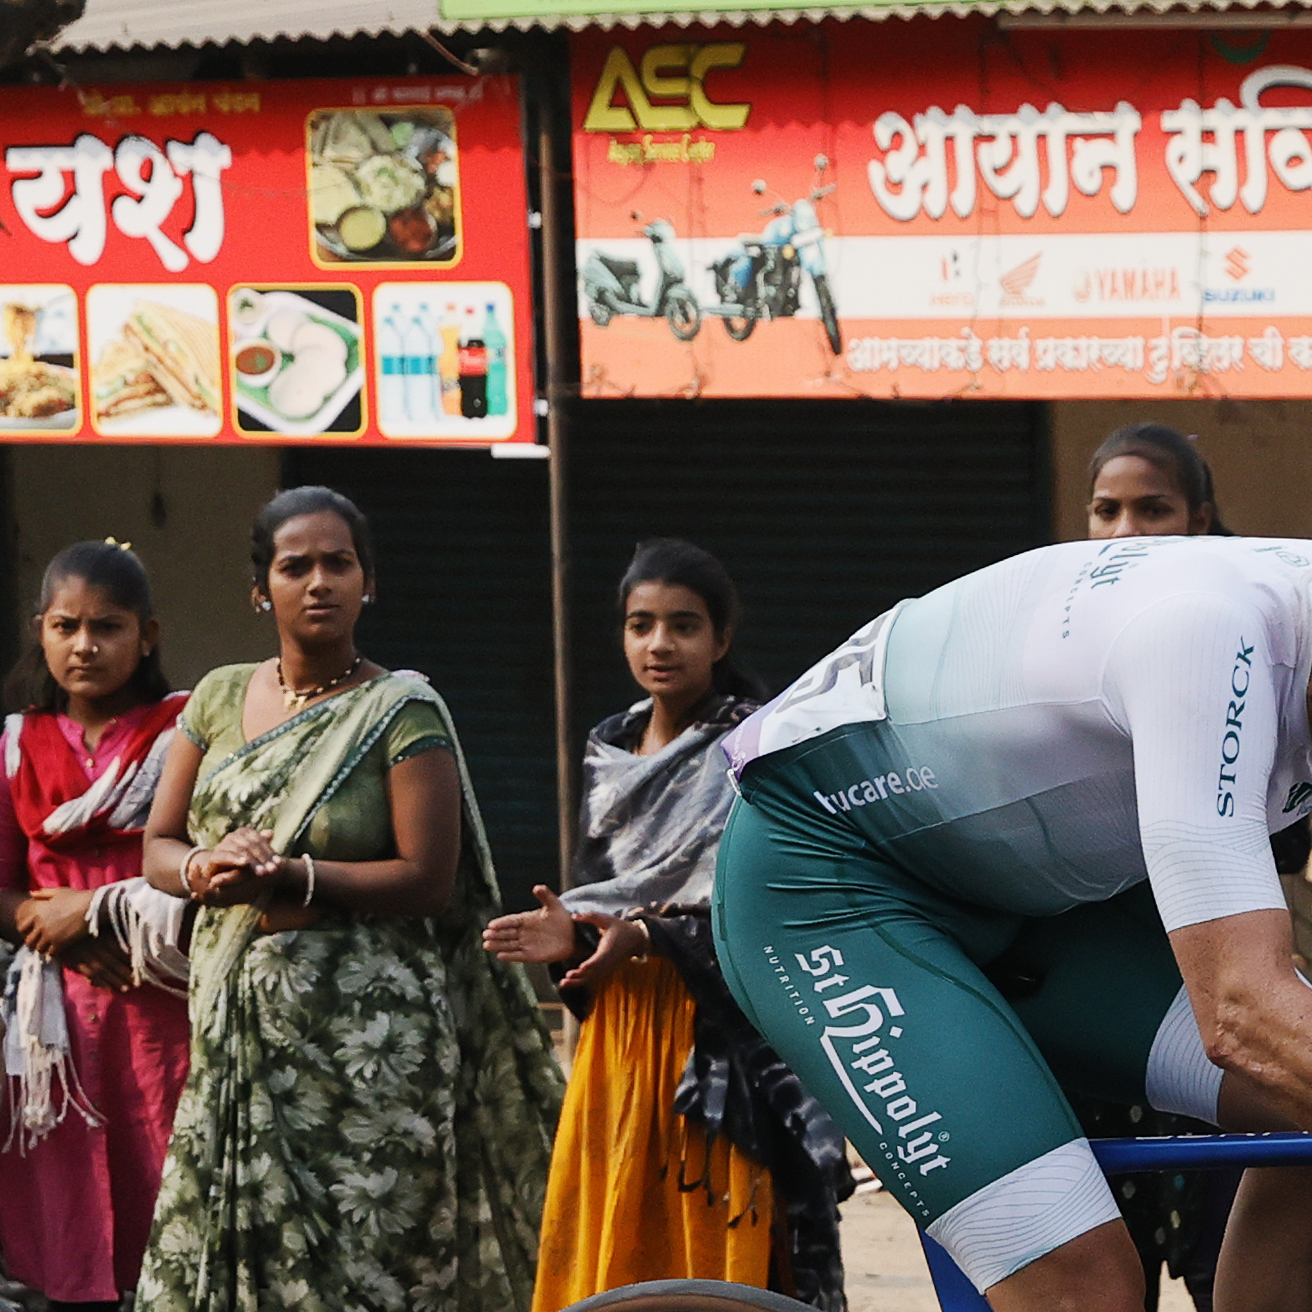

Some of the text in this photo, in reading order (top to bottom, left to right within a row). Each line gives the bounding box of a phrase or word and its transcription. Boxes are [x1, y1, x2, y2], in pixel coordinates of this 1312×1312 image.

[583, 42, 751, 132] ASC
[5, 131, 232, 273] यश
[867, 101, 1143, 222] आयान
[1095, 267, 1182, 302] YAMAHA
[1216, 636, 1257, 818] STORCK
[763, 945, 816, 1026] NUTRITION
[878, 1141, 930, 1218] CONCEPTS
